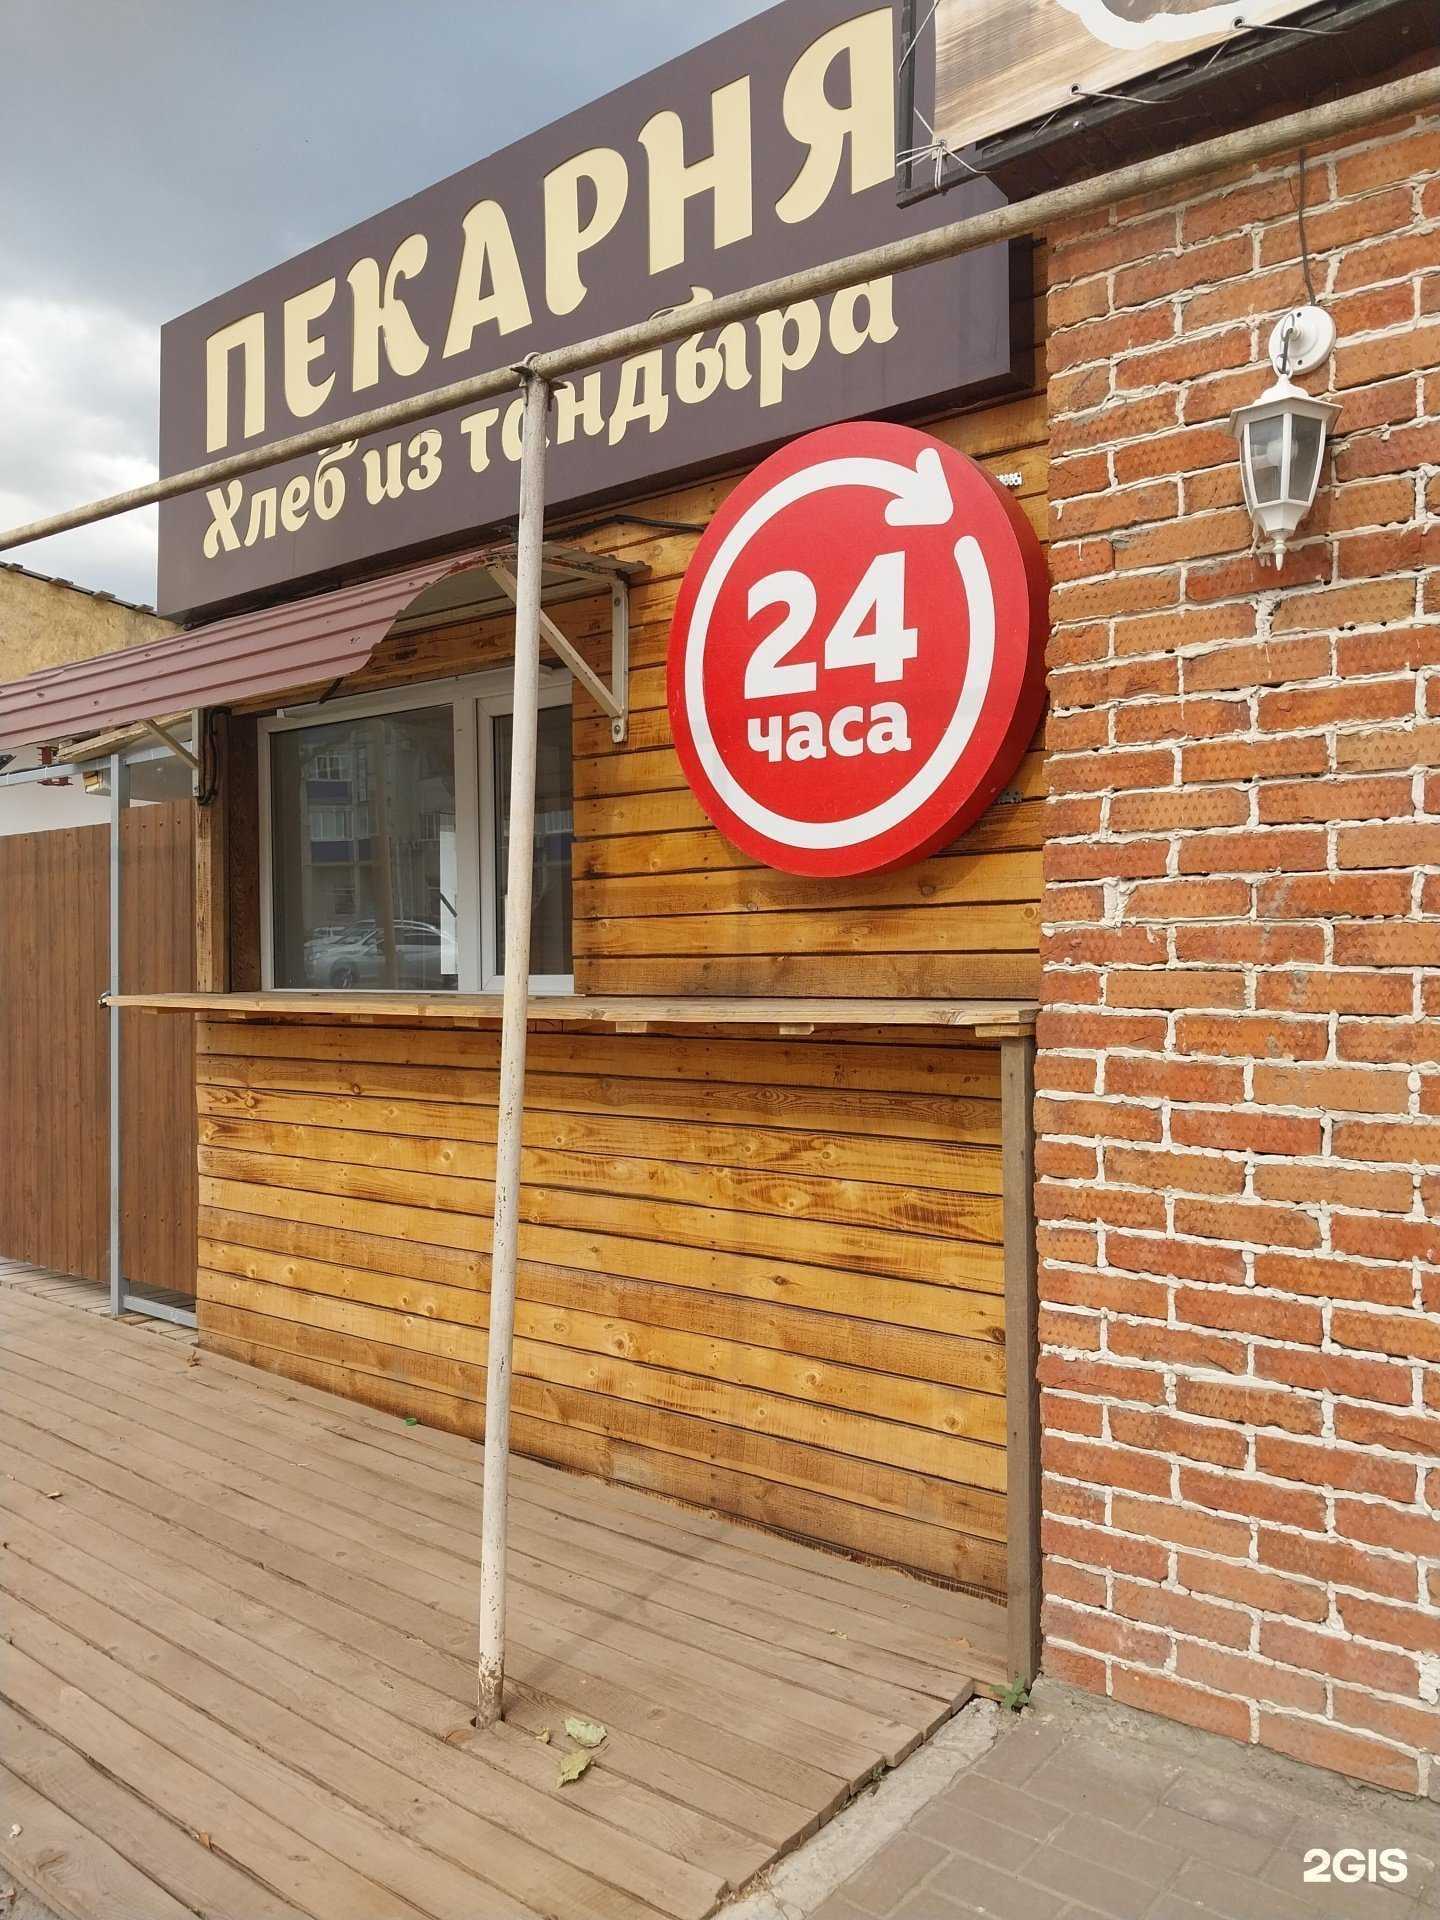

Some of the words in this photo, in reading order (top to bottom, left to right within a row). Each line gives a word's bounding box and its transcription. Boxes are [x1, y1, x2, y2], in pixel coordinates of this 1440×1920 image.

[205, 7, 897, 453] ПЕКАРНЯ
[203, 439, 358, 559] Хлеб
[362, 429, 443, 505] из
[744, 551, 918, 700] 24
[747, 701, 912, 763] часа
